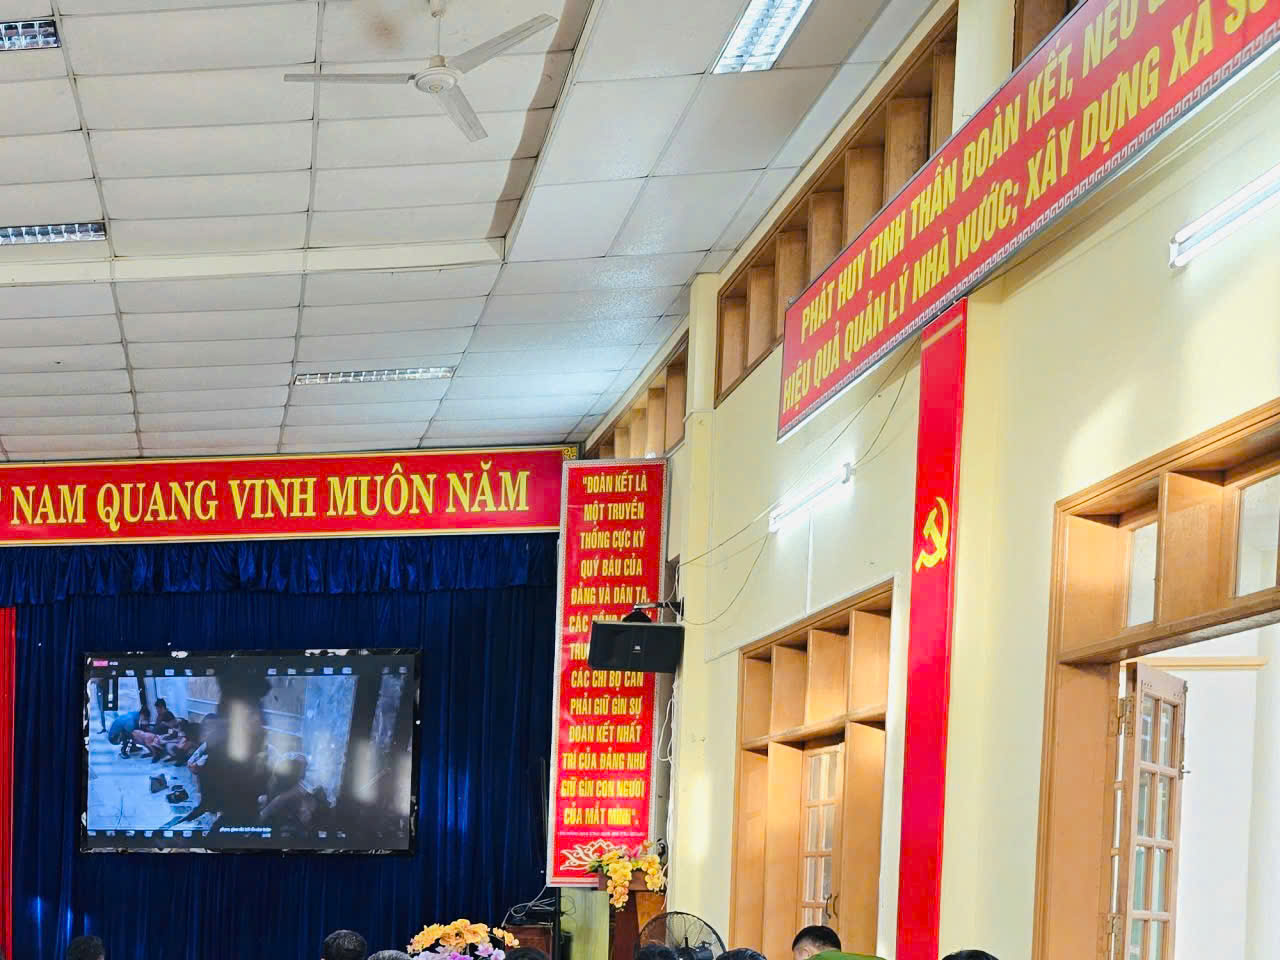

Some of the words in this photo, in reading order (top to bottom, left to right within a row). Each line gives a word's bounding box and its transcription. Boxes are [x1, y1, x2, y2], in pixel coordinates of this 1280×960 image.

[801, 281, 835, 344] PHÁT
[837, 248, 867, 311] HUY
[869, 209, 906, 279] TINH
[911, 156, 957, 240] THẦN
[962, 94, 1020, 192] ĐOÀN
[1026, 37, 1073, 132] KẾT,
[783, 358, 811, 414] HIỆU
[813, 321, 840, 388] QUẢ
[844, 290, 886, 363] QUẢN
[888, 262, 909, 324] LÝ
[912, 226, 950, 304] NHÀ
[955, 179, 1019, 268] NƯỚC;
[1024, 120, 1075, 209] XÂY
[1080, 45, 1160, 161] DỰNG
[615, 469, 633, 492] KẾT
[635, 470, 647, 491] LÀ
[11, 483, 86, 525] NAM
[97, 480, 218, 531] QUANG
[228, 476, 317, 519] VINH
[327, 462, 436, 516] MUÔN
[446, 459, 529, 513] NĂM
[584, 500, 605, 525] MỘT
[608, 496, 644, 520] TRUYỀN
[580, 526, 610, 549] THỐNG
[612, 528, 631, 552] CỰC
[633, 526, 645, 548] KỲ
[581, 555, 599, 579] QUÝ
[602, 555, 621, 576] BÁU
[624, 553, 642, 576] CỦA
[571, 581, 596, 605] ĐẢNG
[599, 582, 610, 604] VÀ
[614, 584, 632, 604] DÂN
[569, 612, 588, 632] CÁC
[571, 667, 590, 687] CÁC
[570, 692, 592, 715] PHẢI
[594, 694, 610, 715] GIỮ
[611, 694, 626, 714] GÌN
[629, 696, 642, 719] SỰ
[568, 721, 594, 743] ĐOÀN
[596, 720, 614, 742] KẾT
[616, 720, 642, 742] NHẤT
[562, 750, 576, 769] TRÍ
[578, 746, 597, 769] CỦA
[600, 747, 625, 769] ĐẢNG
[627, 750, 647, 769] NHƯ
